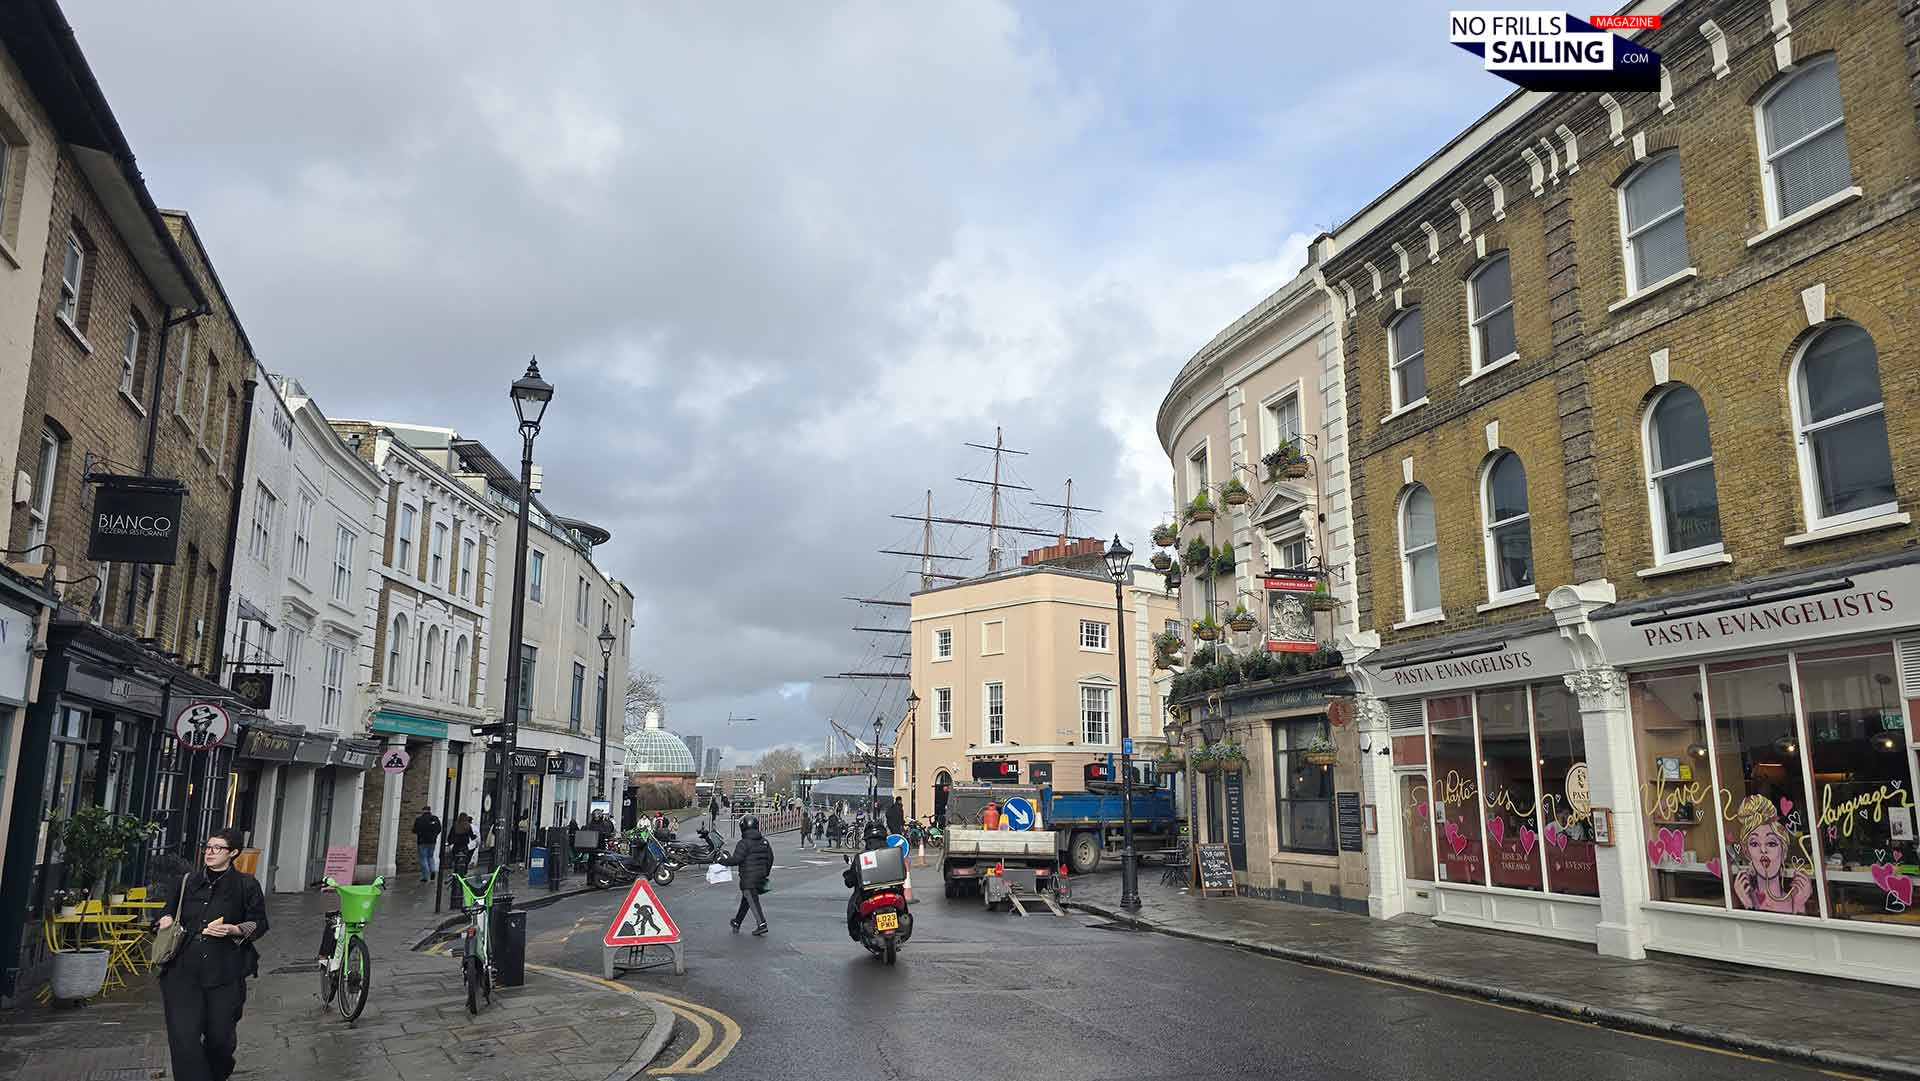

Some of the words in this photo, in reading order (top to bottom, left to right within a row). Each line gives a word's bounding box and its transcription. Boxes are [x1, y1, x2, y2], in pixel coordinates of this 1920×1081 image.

[98, 513, 172, 532] BIANCO
[129, 529, 169, 537] RISTORANTE
[1643, 620, 1711, 647] PASTA
[1719, 589, 1895, 636] EVANGELISTS
[1394, 665, 1437, 686] PASTA
[1436, 650, 1533, 679] EVANGELISTS
[1645, 765, 1706, 820] love
[1818, 783, 1895, 837] language
[863, 855, 873, 866] L
